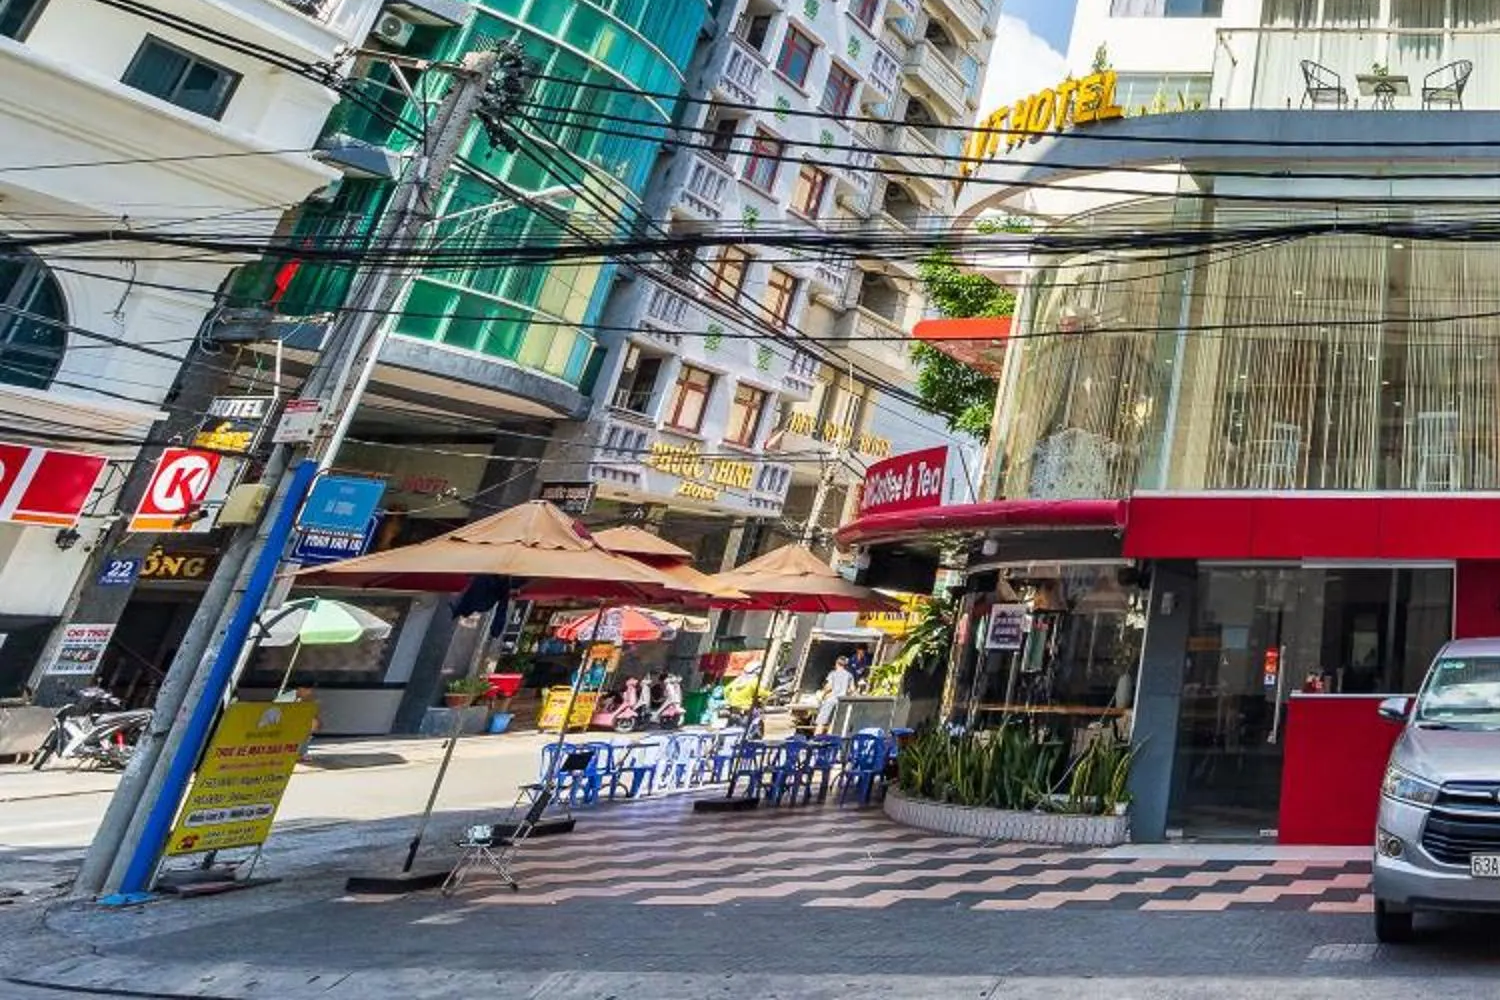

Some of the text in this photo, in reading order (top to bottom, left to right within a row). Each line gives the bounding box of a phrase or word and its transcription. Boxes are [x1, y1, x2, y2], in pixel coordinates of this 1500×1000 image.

[1006, 70, 1123, 148] HOTEL
[165, 467, 206, 513] K
[916, 461, 942, 497] Tea
[107, 560, 134, 577] 22
